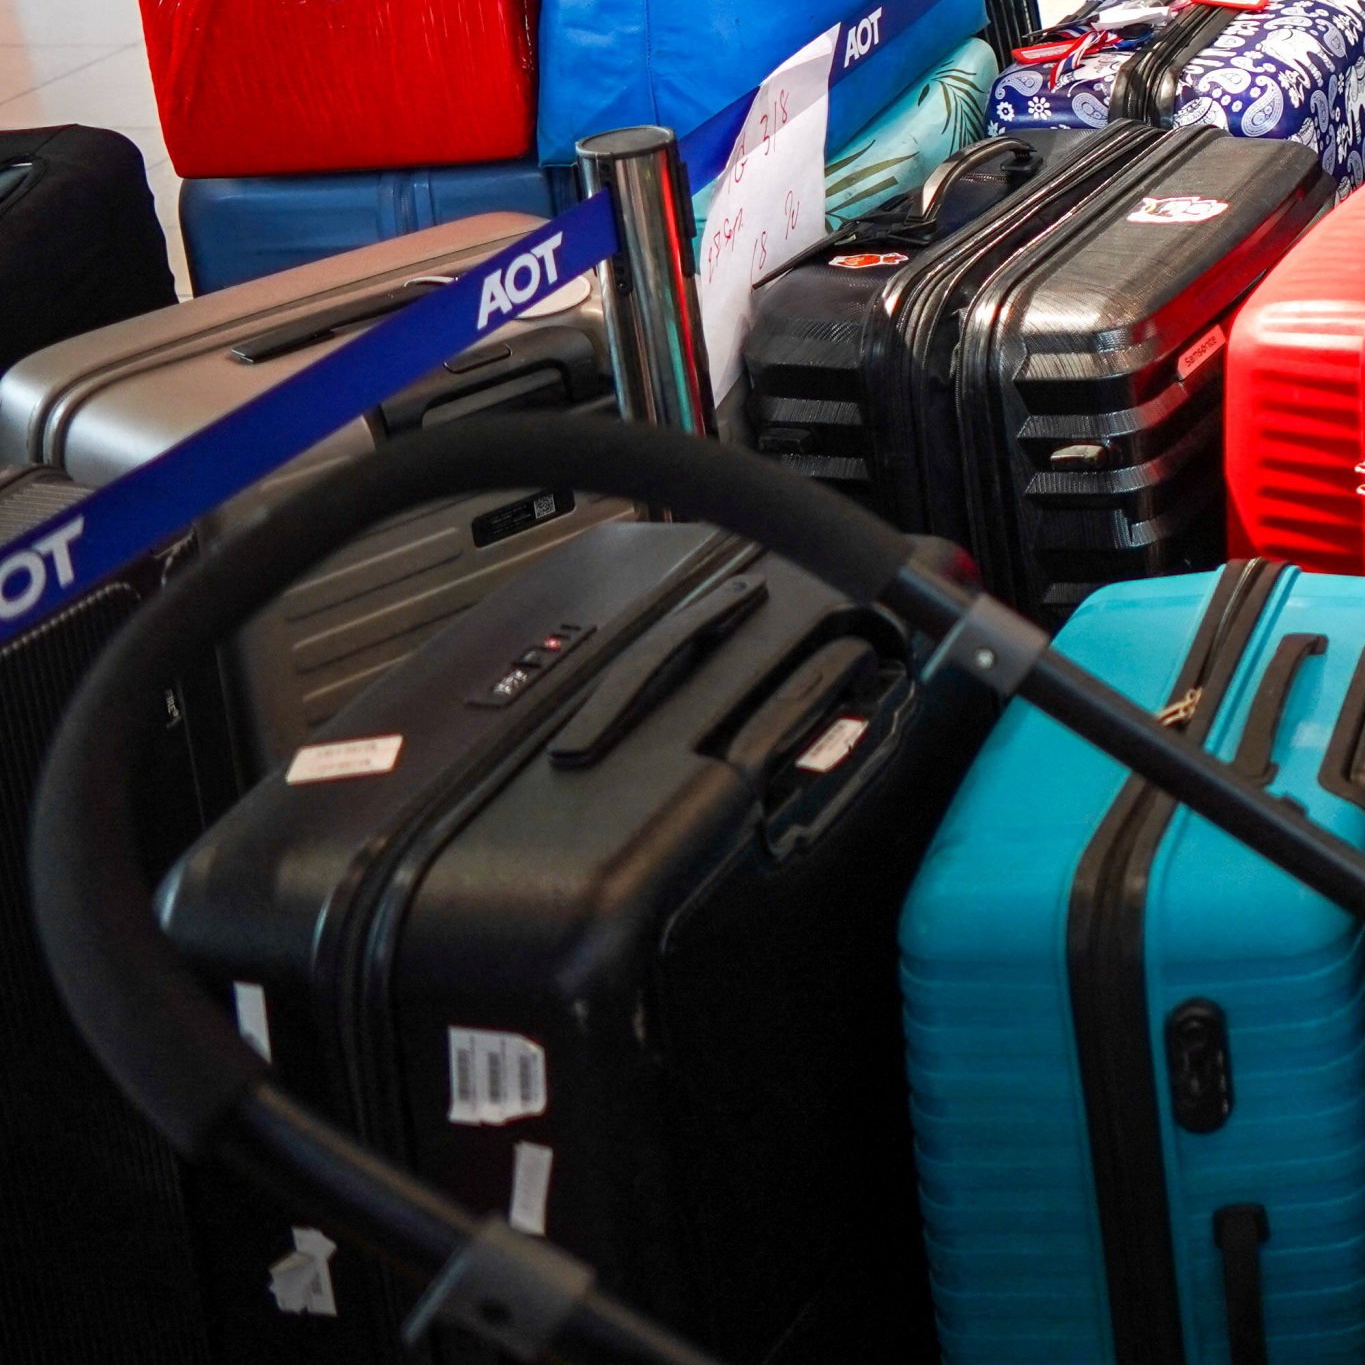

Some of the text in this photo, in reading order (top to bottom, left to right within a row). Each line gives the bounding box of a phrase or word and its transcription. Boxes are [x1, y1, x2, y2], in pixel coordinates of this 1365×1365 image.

[843, 6, 883, 68] AOT
[476, 231, 564, 331] AOT
[1183, 335, 1218, 368] Samsonite
